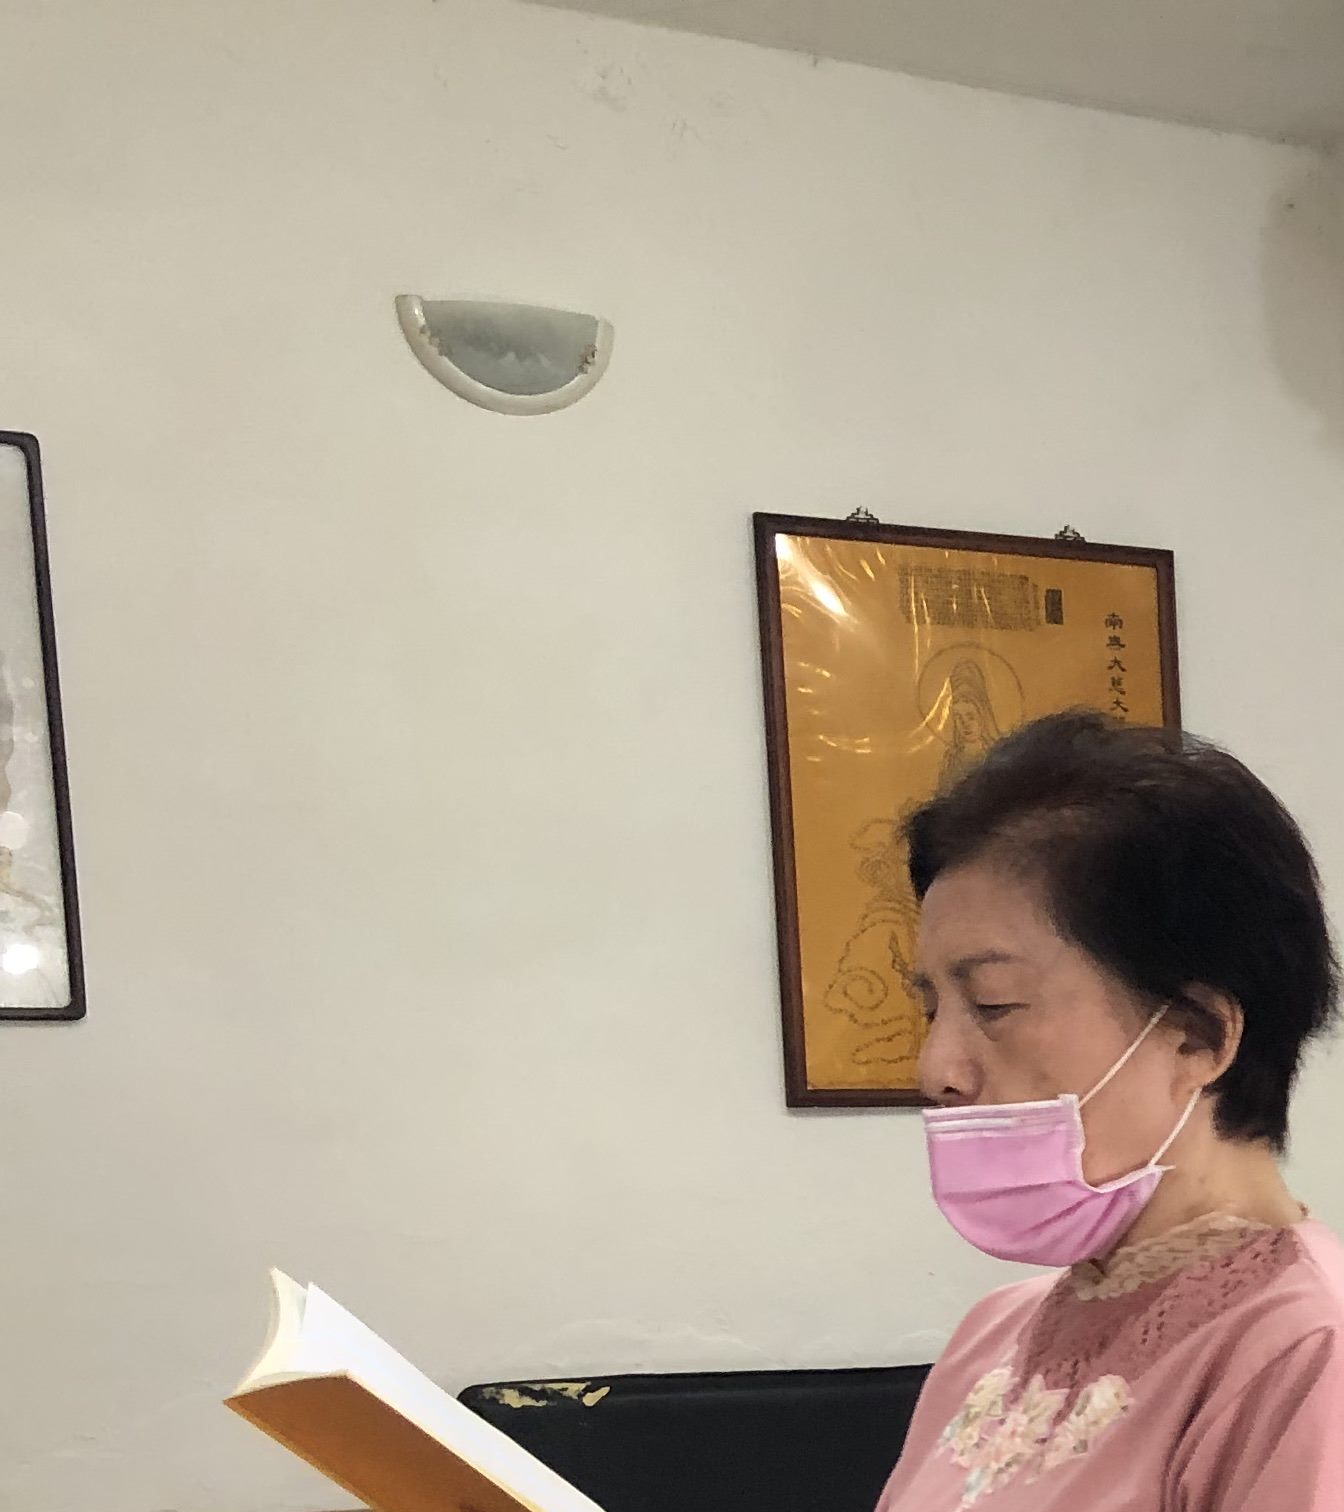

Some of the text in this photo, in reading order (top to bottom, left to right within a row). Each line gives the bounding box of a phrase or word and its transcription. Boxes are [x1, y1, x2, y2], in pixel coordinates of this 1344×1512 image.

[1105, 612, 1129, 720] 南無大慈大
